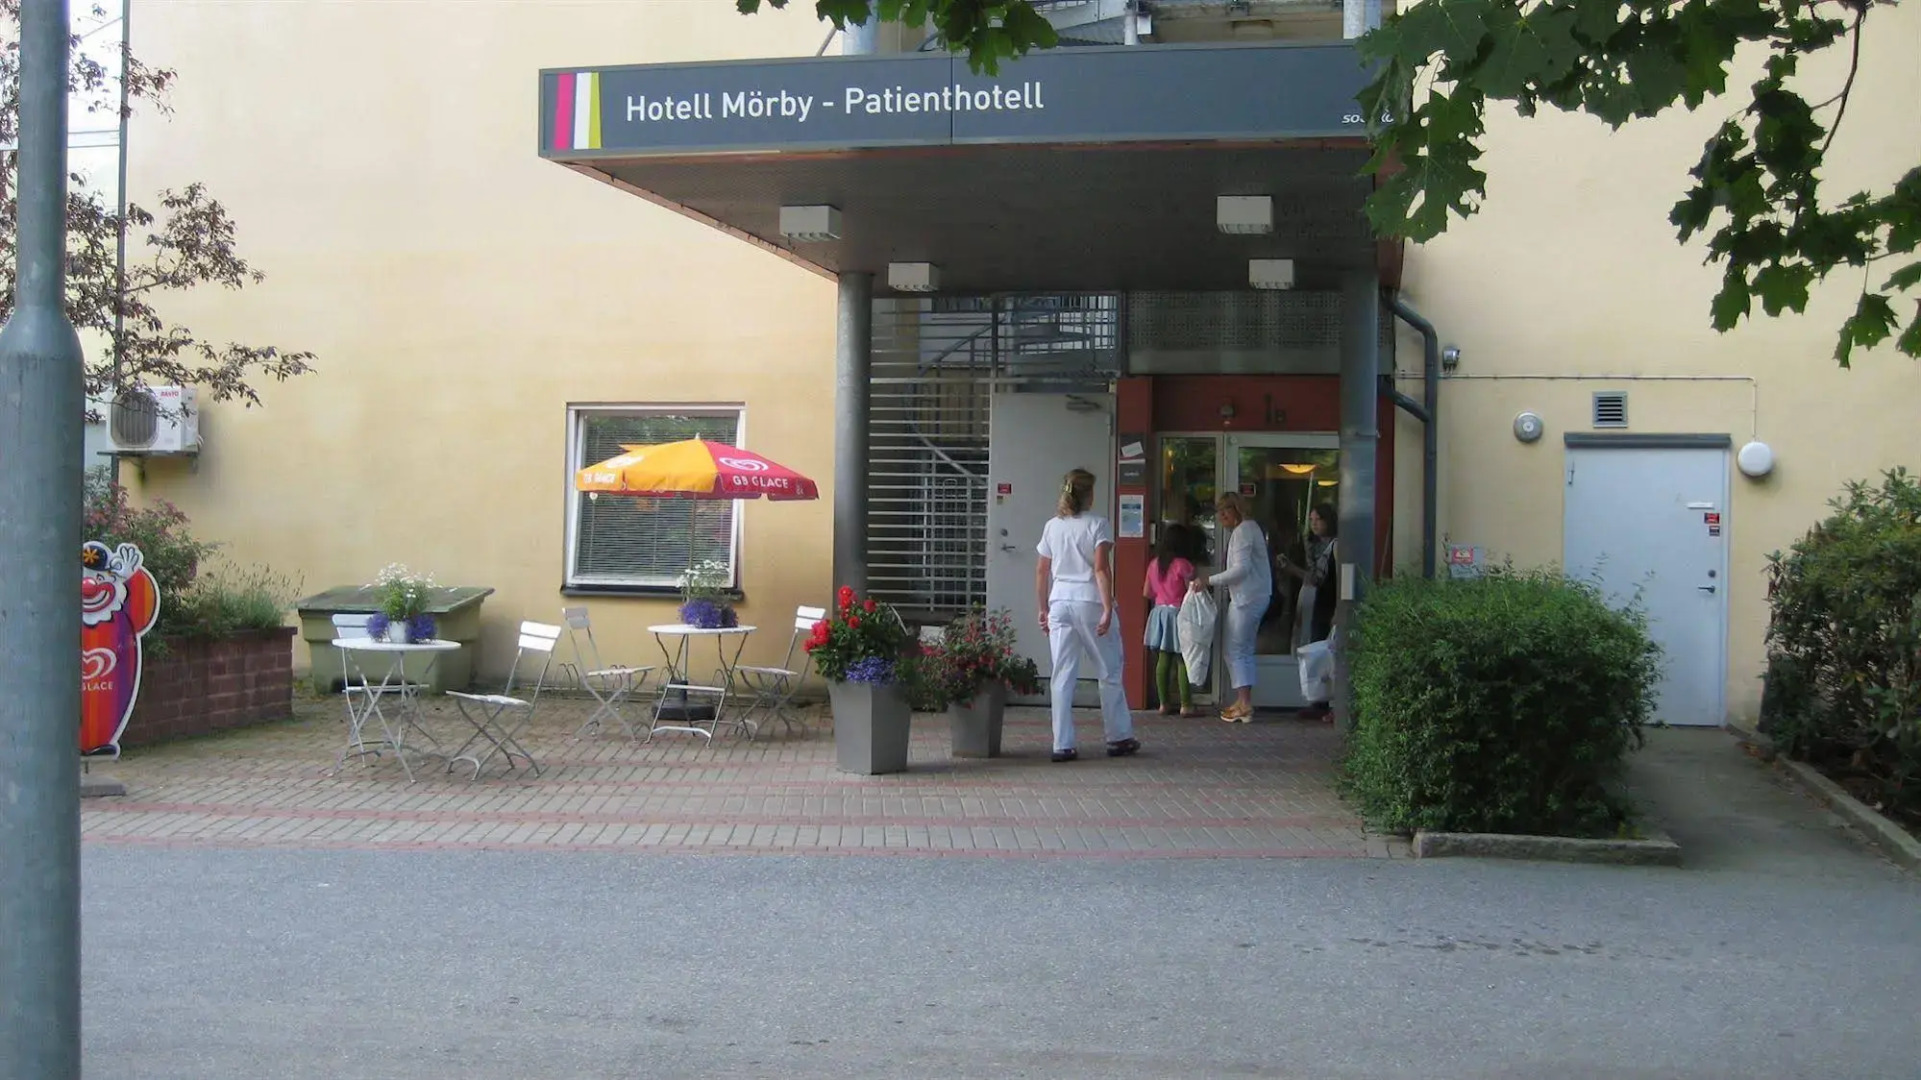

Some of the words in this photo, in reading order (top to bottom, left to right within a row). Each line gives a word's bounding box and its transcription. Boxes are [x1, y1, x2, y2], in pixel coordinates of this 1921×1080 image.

[626, 93, 713, 122] Hotell
[722, 90, 814, 122] Mörby
[845, 81, 1045, 114] Patienthotell
[732, 475, 749, 486] GB
[751, 476, 789, 489] GLACE
